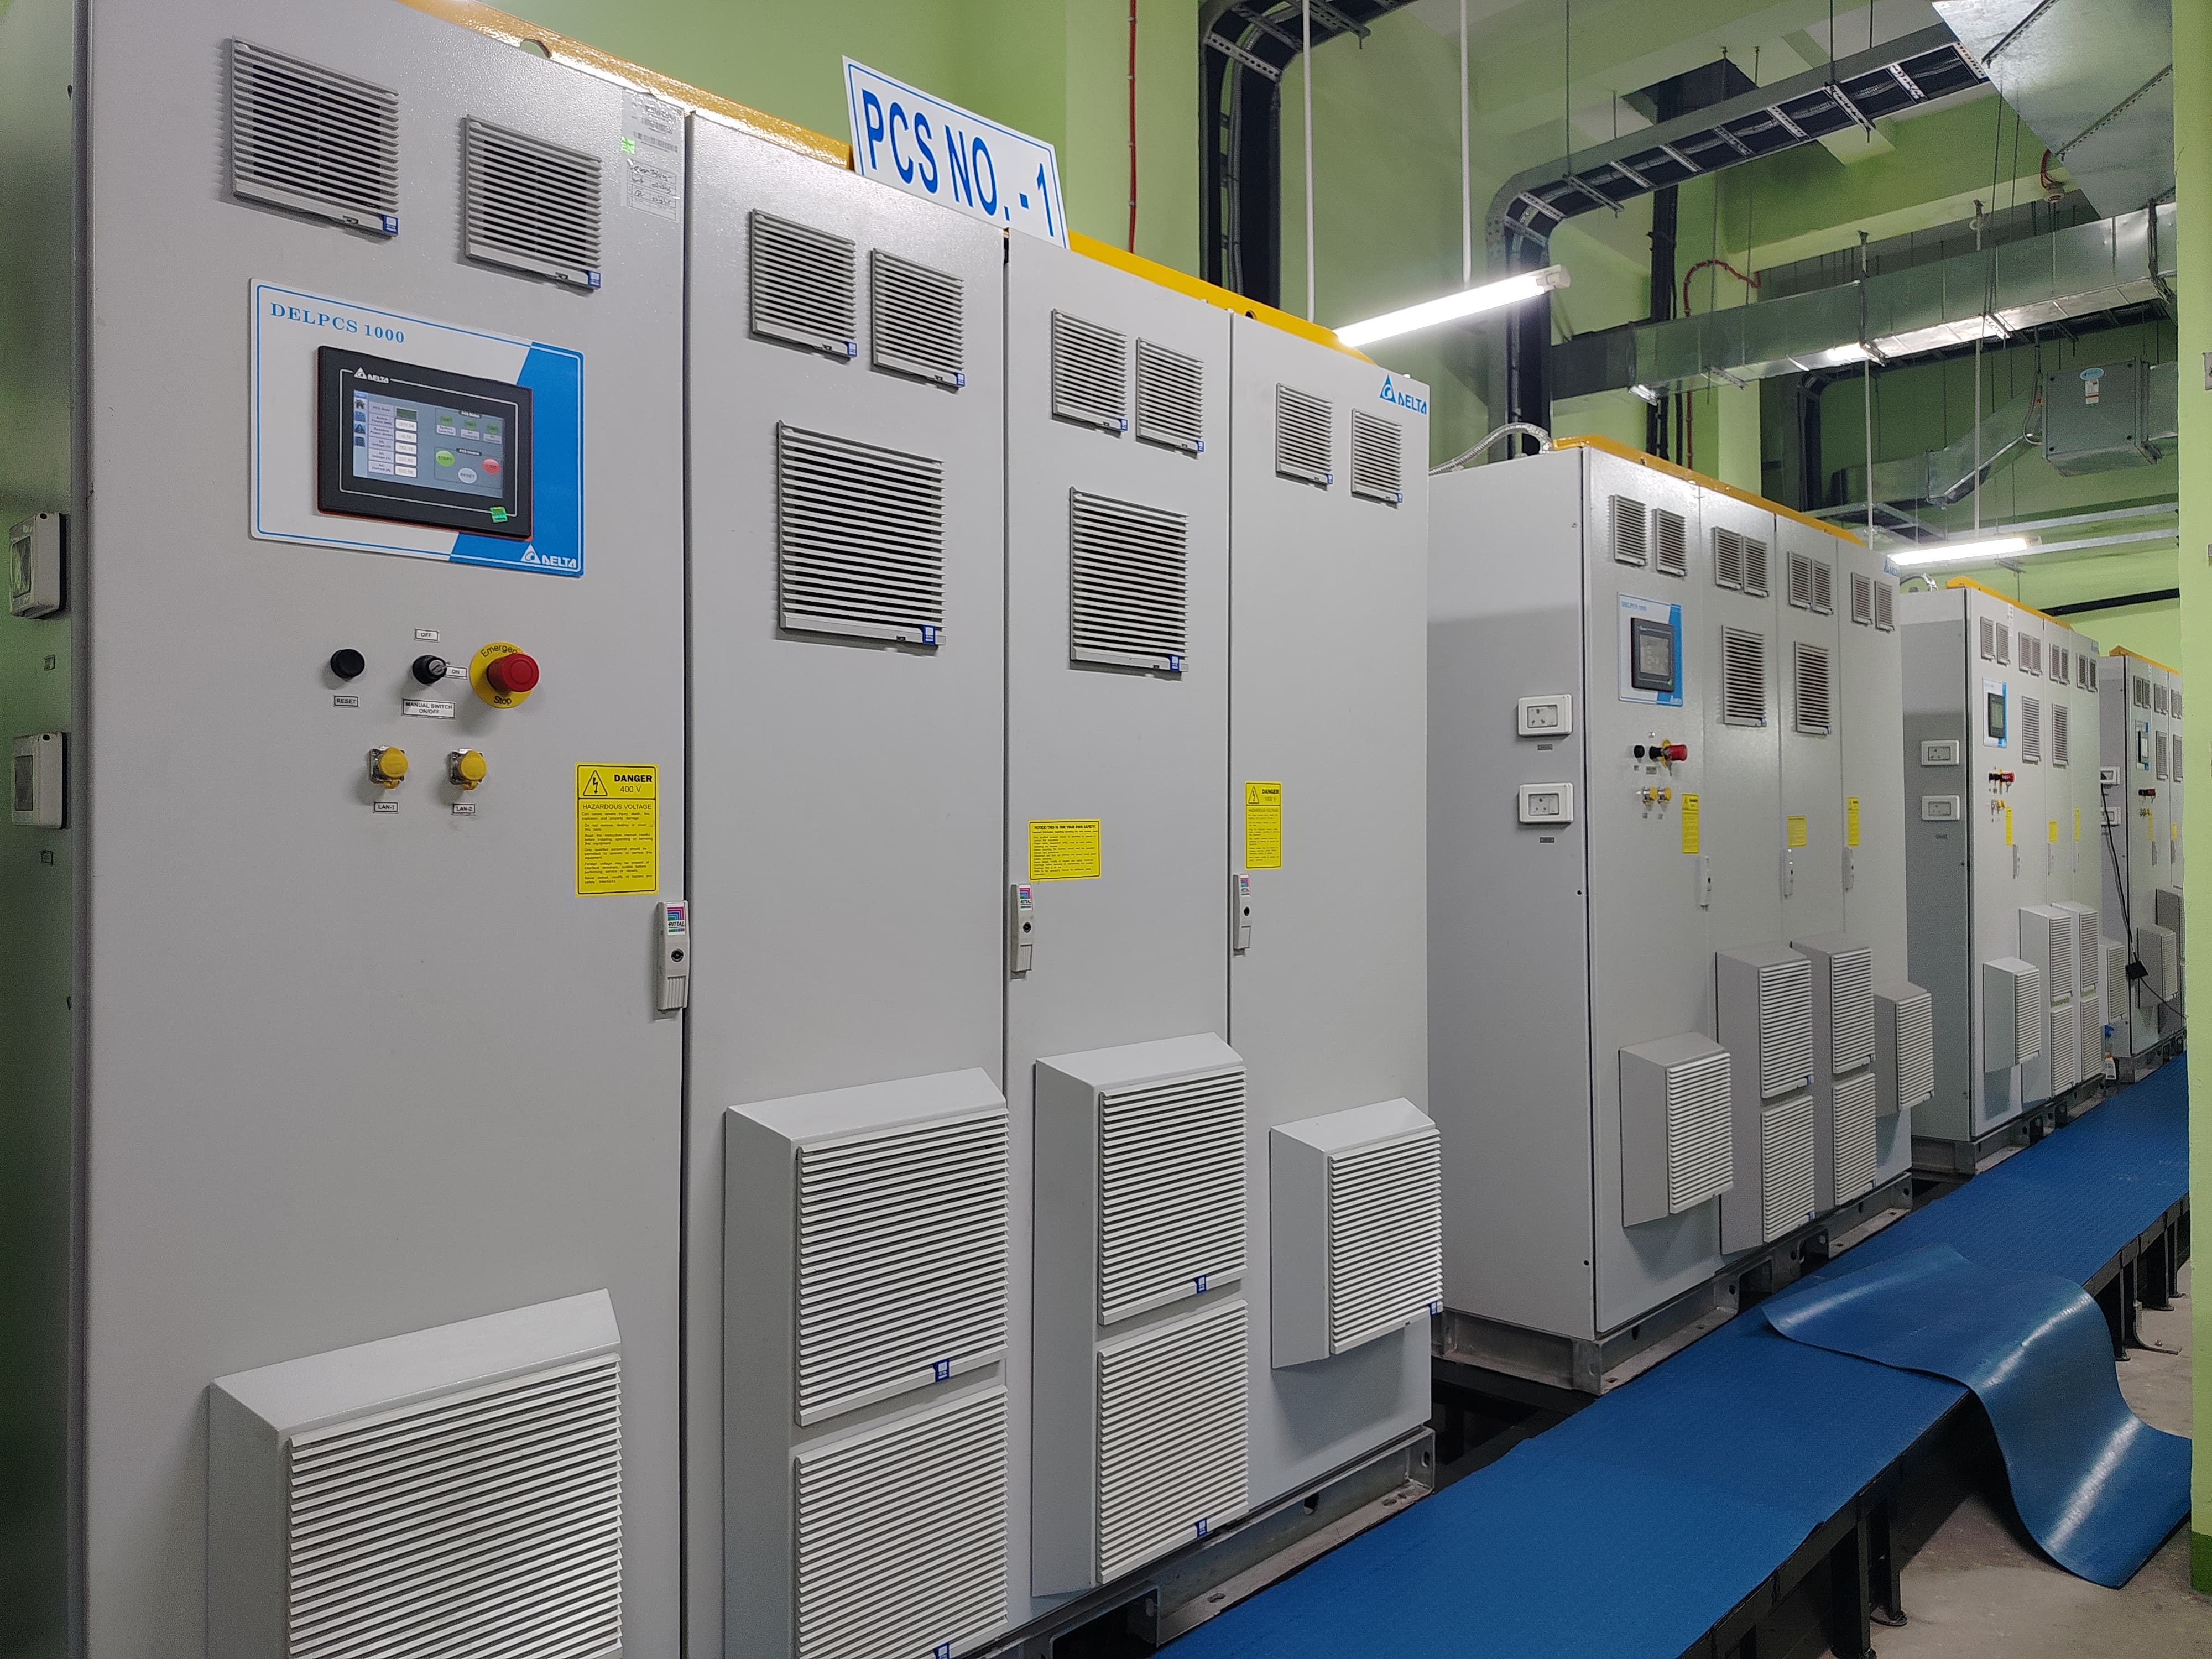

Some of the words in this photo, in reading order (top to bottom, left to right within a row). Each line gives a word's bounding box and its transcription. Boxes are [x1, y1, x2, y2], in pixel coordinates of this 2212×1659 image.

[861, 88, 938, 194] PCS
[270, 302, 358, 333] DELPCS
[364, 325, 405, 343] 1000
[367, 373, 389, 383] DELTA
[1397, 392, 1427, 415] DELTA
[541, 555, 577, 568] DELTA
[481, 645, 518, 658] Emergen
[494, 696, 512, 706] Stop
[614, 774, 653, 782] DANGER
